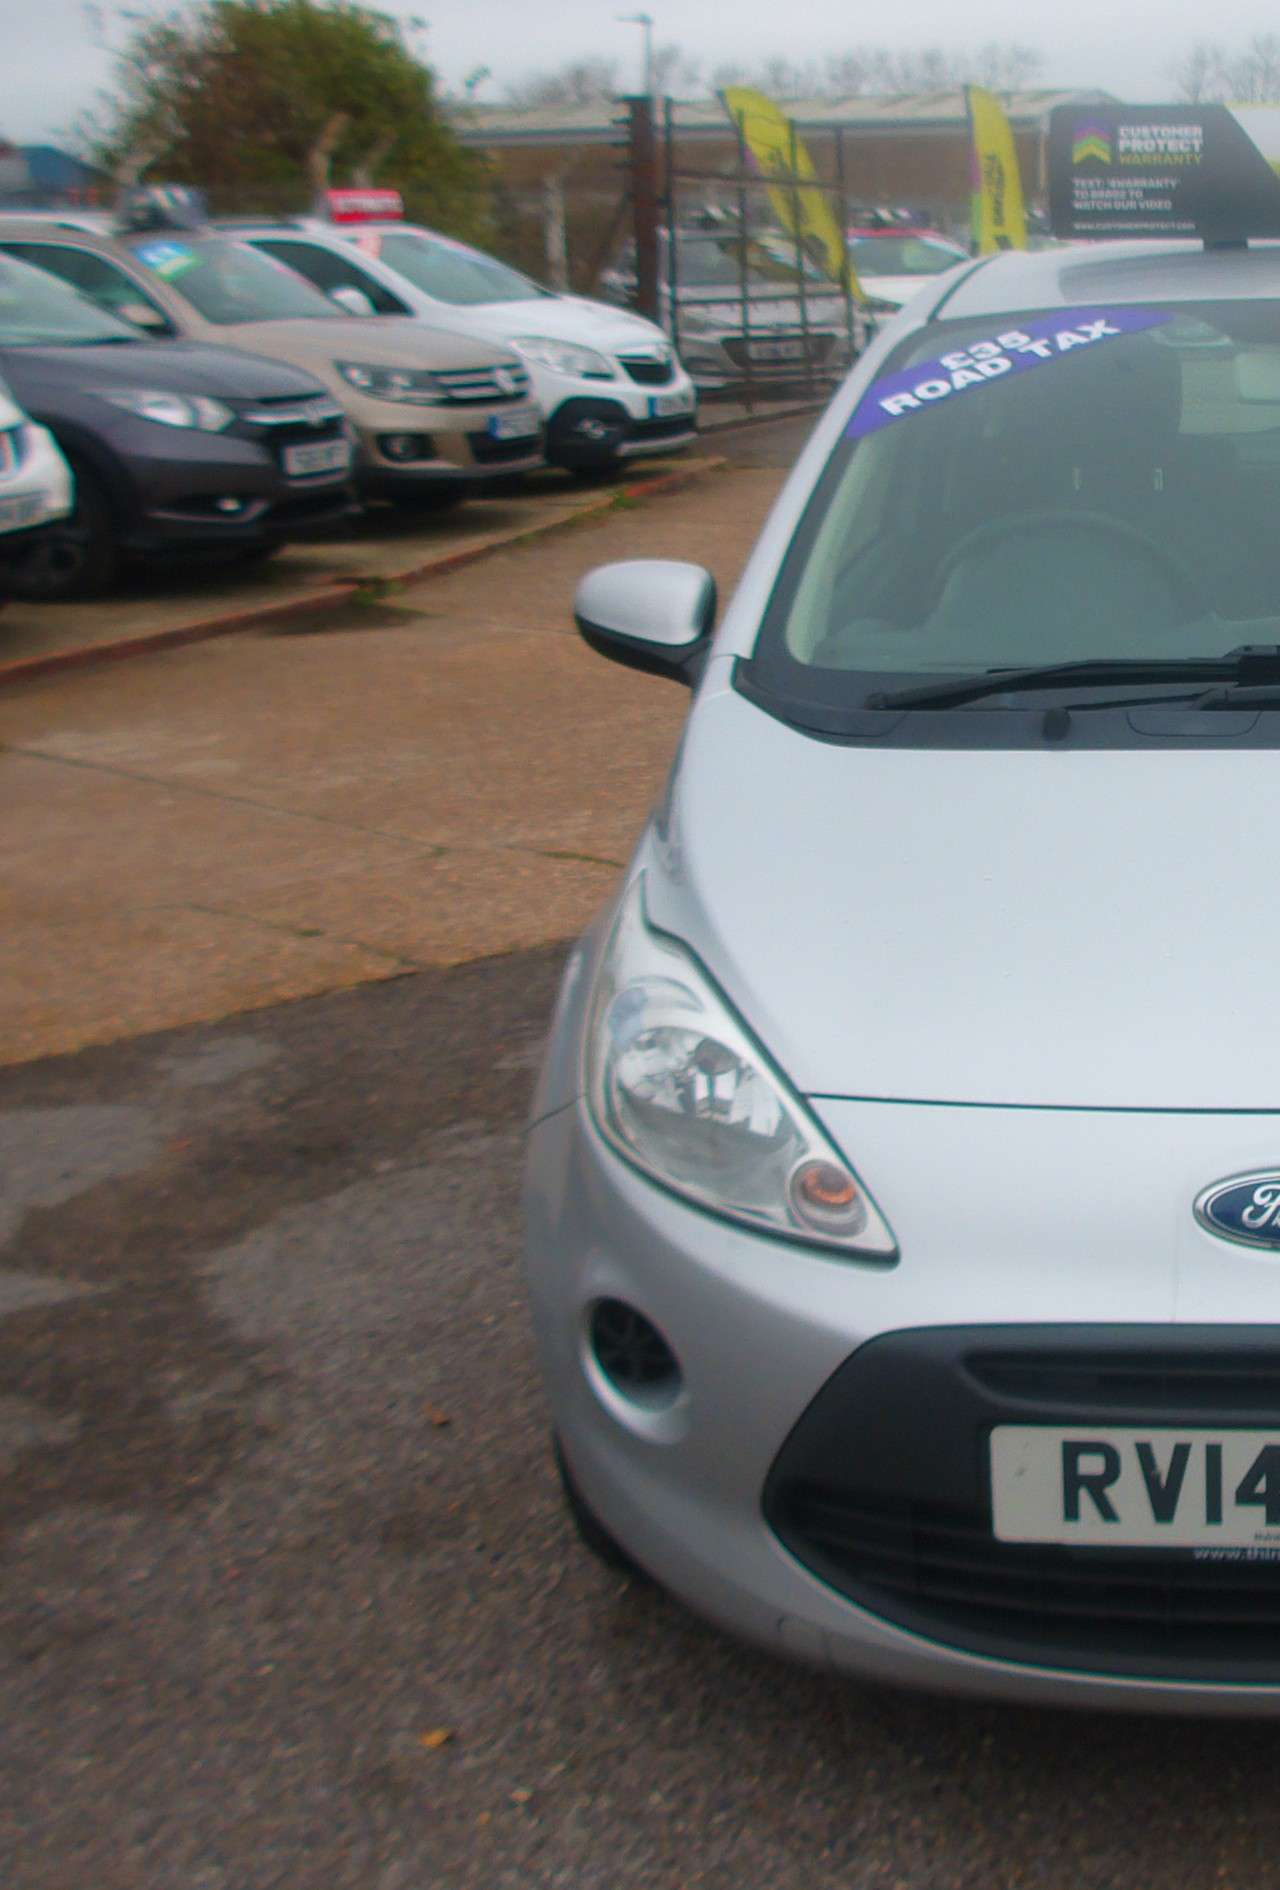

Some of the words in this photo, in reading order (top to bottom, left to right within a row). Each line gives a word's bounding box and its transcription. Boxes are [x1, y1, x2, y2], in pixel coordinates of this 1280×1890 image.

[1119, 126, 1202, 139] CUSTOMER
[1119, 140, 1202, 153] PROTECT
[1119, 154, 1202, 166] WARRANTY
[1073, 200, 1112, 210] WATCH
[1114, 200, 1137, 210] OUR
[1139, 200, 1173, 210] VIDEO
[879, 357, 1012, 416] ROAD
[1018, 319, 1121, 358] TAX
